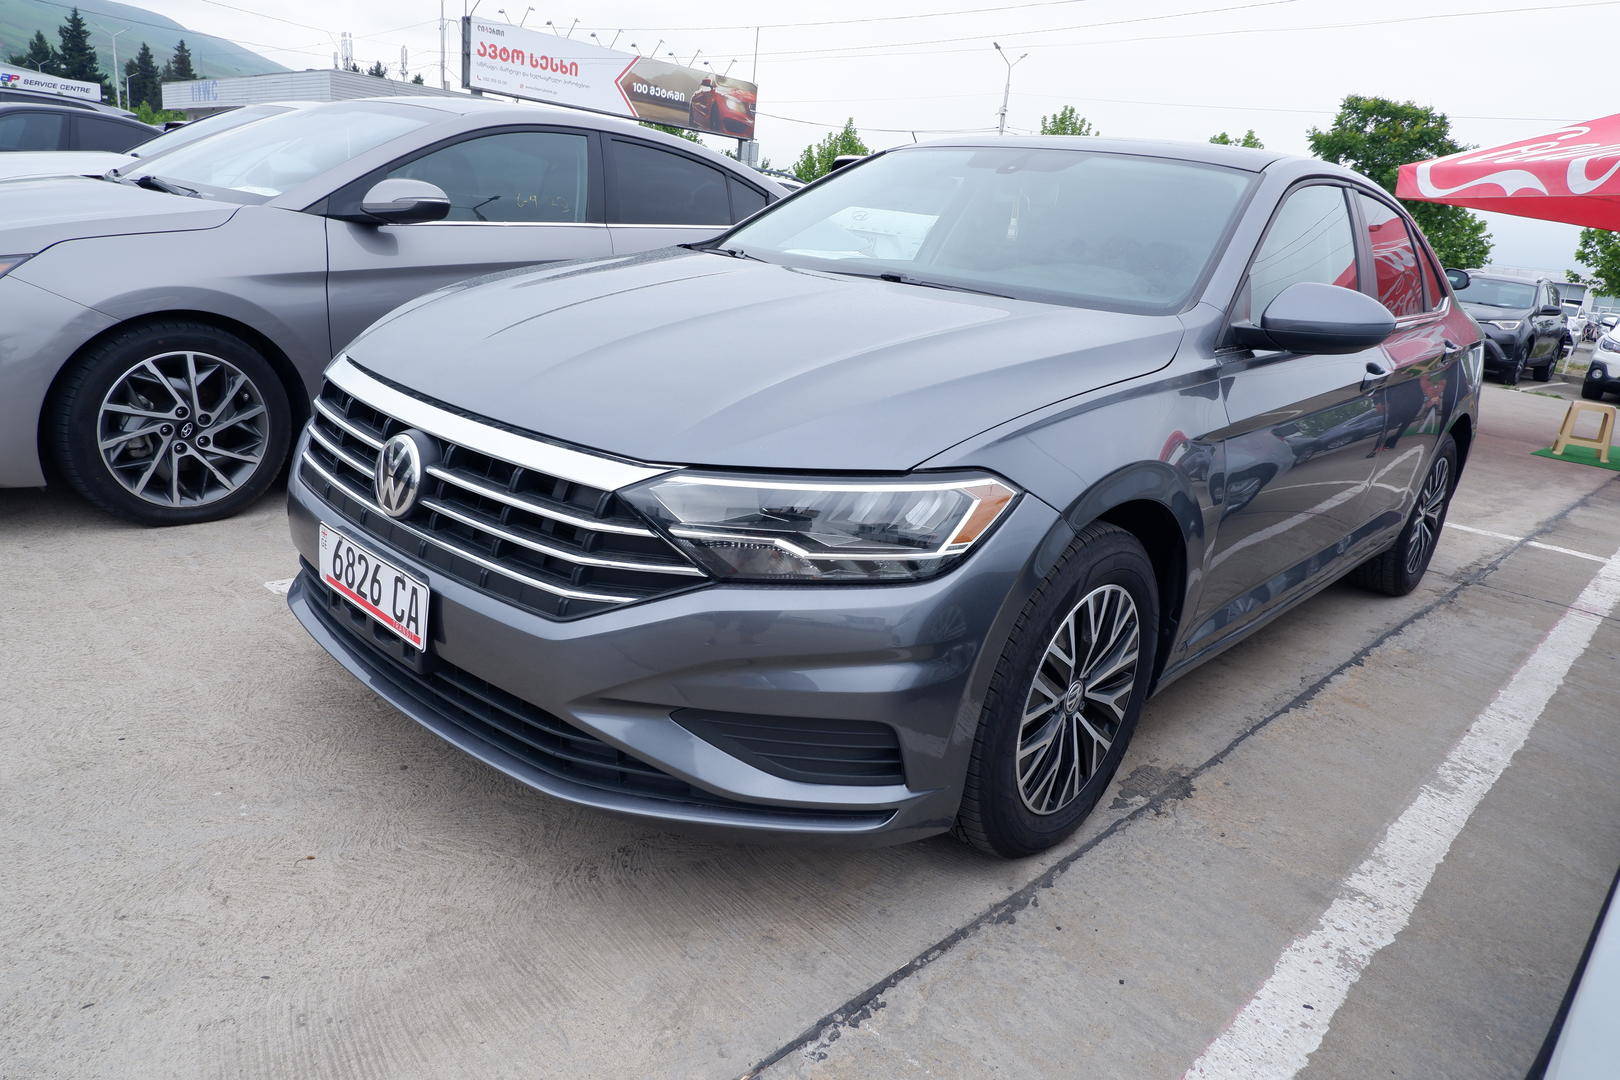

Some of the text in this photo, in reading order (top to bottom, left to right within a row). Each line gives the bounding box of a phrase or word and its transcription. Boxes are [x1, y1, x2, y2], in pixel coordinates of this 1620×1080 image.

[476, 41, 579, 77] ავტო სესხი
[23, 79, 58, 89] SERVICE
[60, 84, 91, 94] CENTRE
[632, 82, 685, 102] 100 მეტრში
[333, 539, 419, 635] 6826 CA
